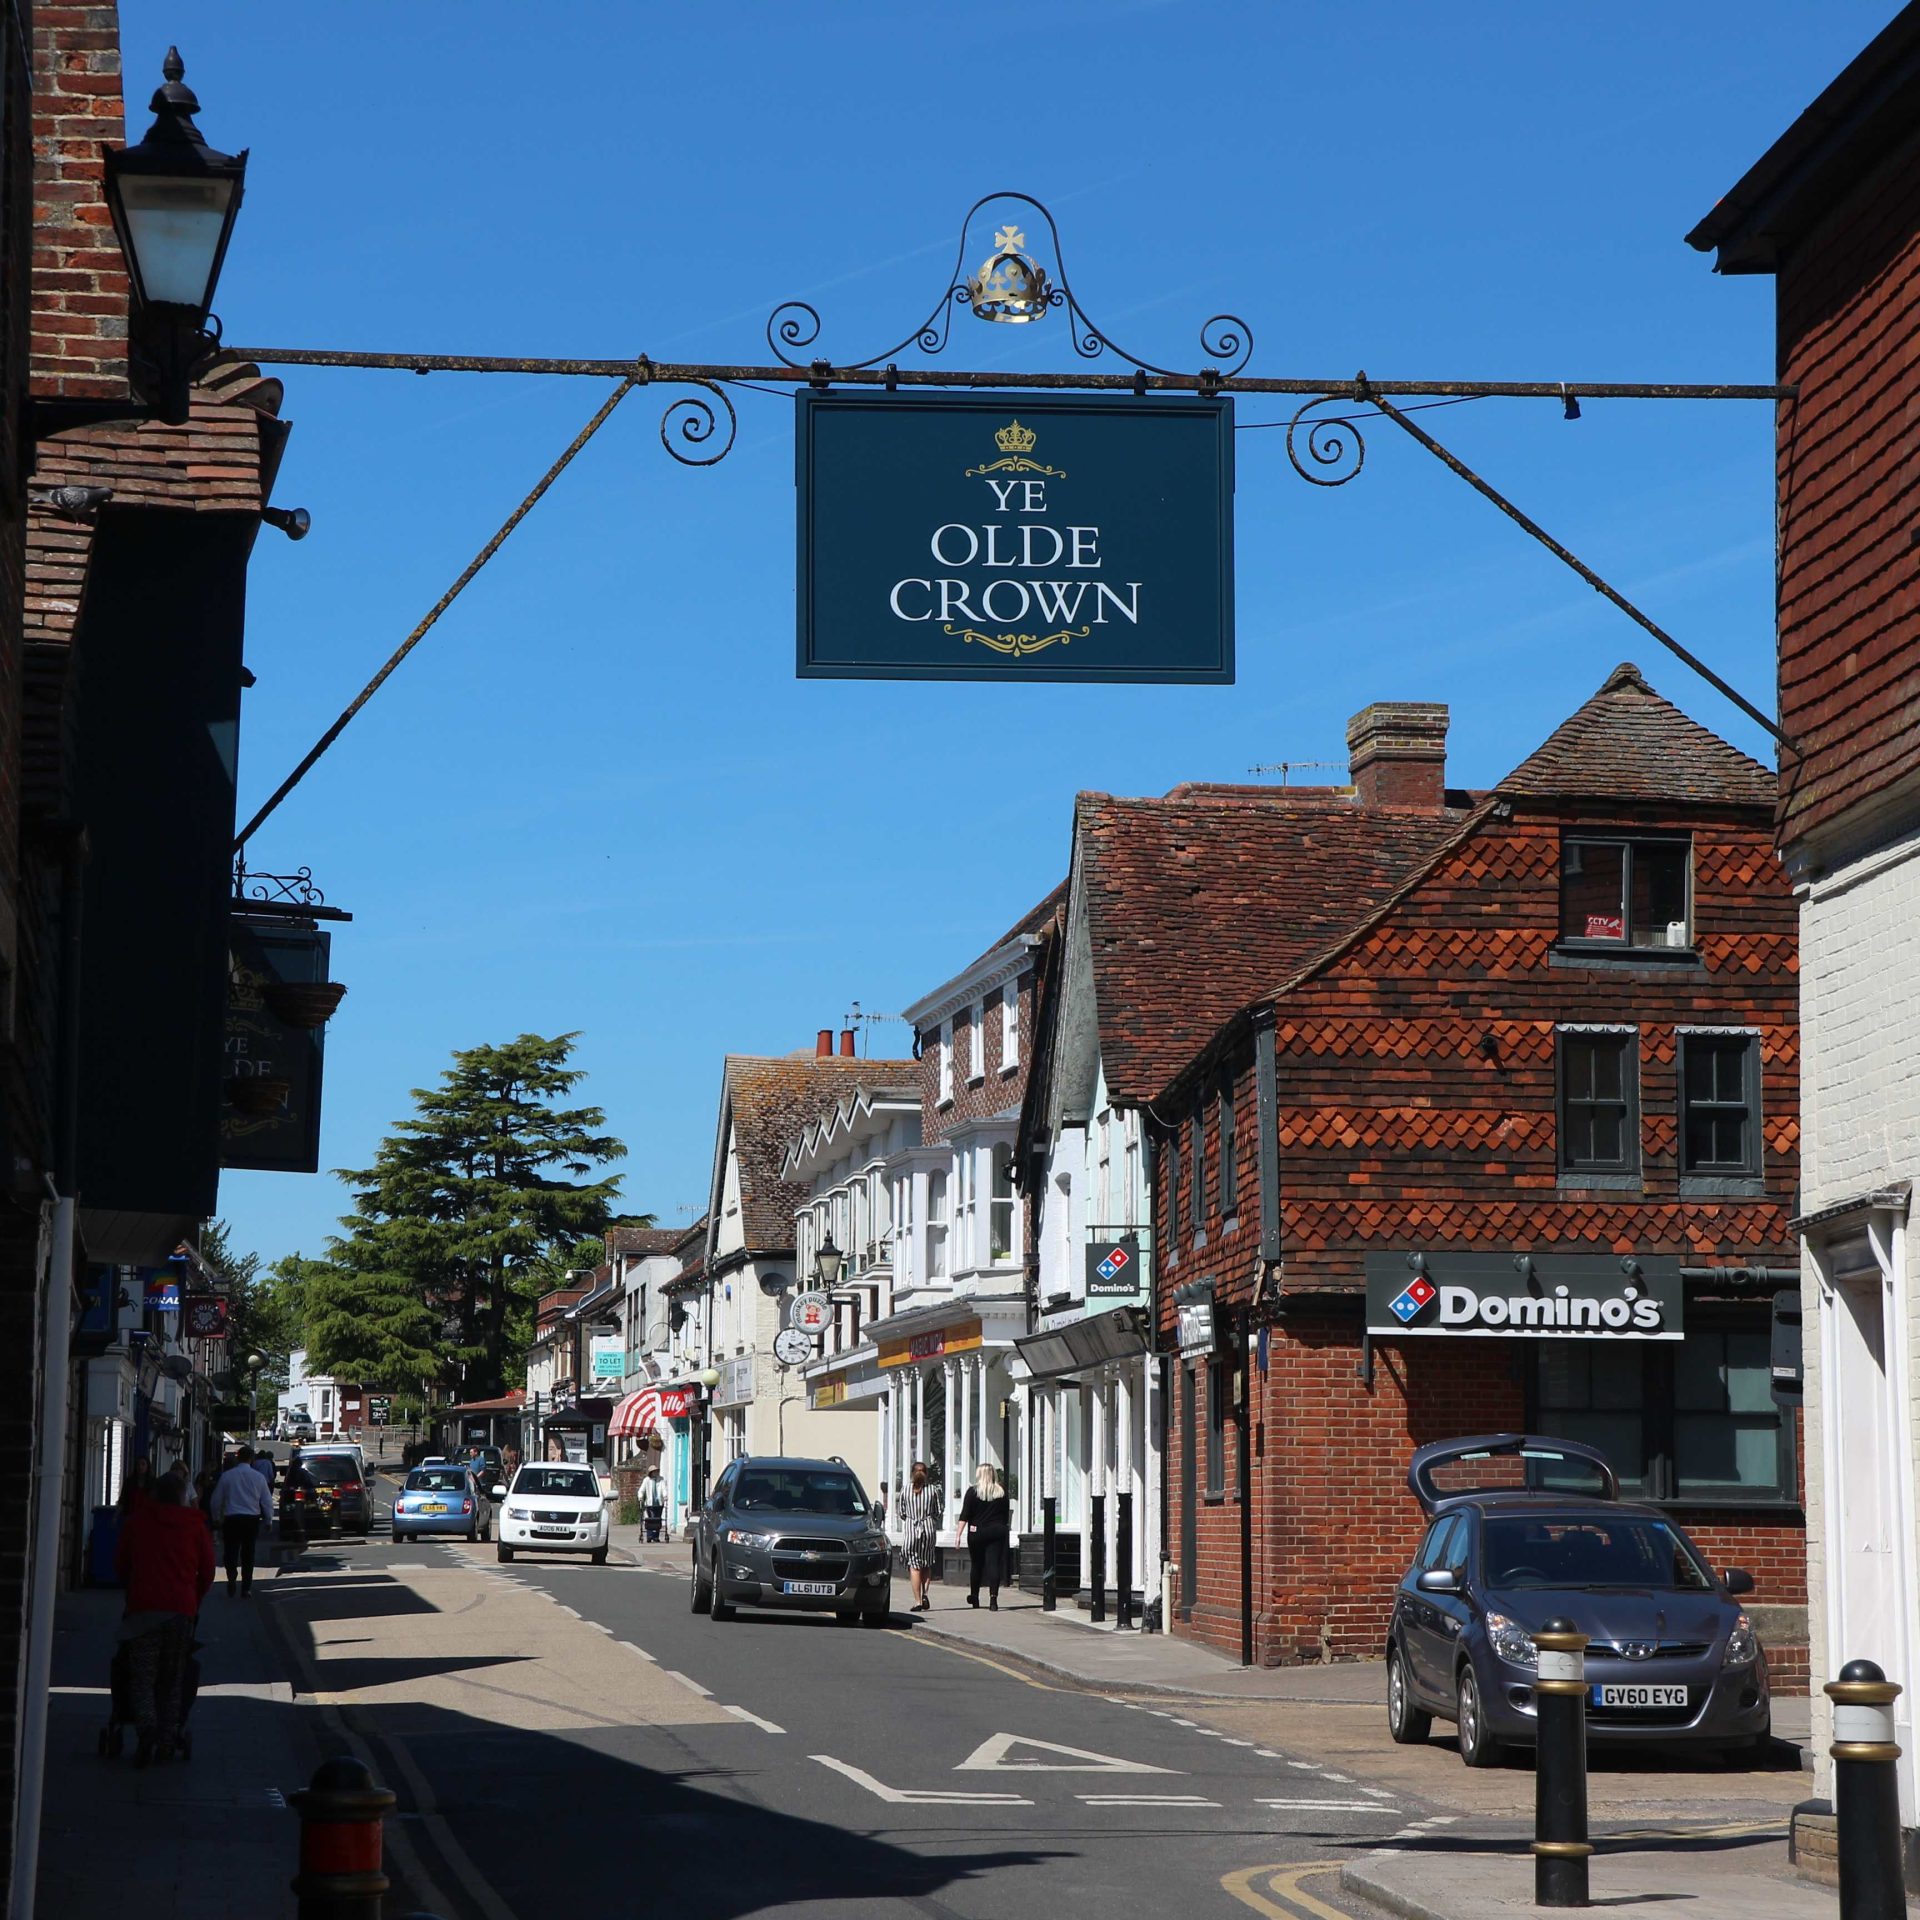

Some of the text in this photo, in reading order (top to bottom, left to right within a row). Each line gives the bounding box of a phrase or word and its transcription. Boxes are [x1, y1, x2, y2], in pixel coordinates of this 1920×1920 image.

[985, 479, 1048, 512] YE
[930, 523, 1102, 568] OLDE
[889, 578, 1143, 624] CROWN
[1588, 916, 1609, 926] CCTV
[1090, 1283, 1135, 1294] Domino's
[143, 1296, 180, 1305] CORAL
[795, 1297, 828, 1324] monkey puzzle
[1440, 1284, 1660, 1329] Domino's
[663, 1394, 685, 1416] illy
[792, 1583, 812, 1594] LL61
[1605, 1688, 1684, 1704] GV60 EYG
